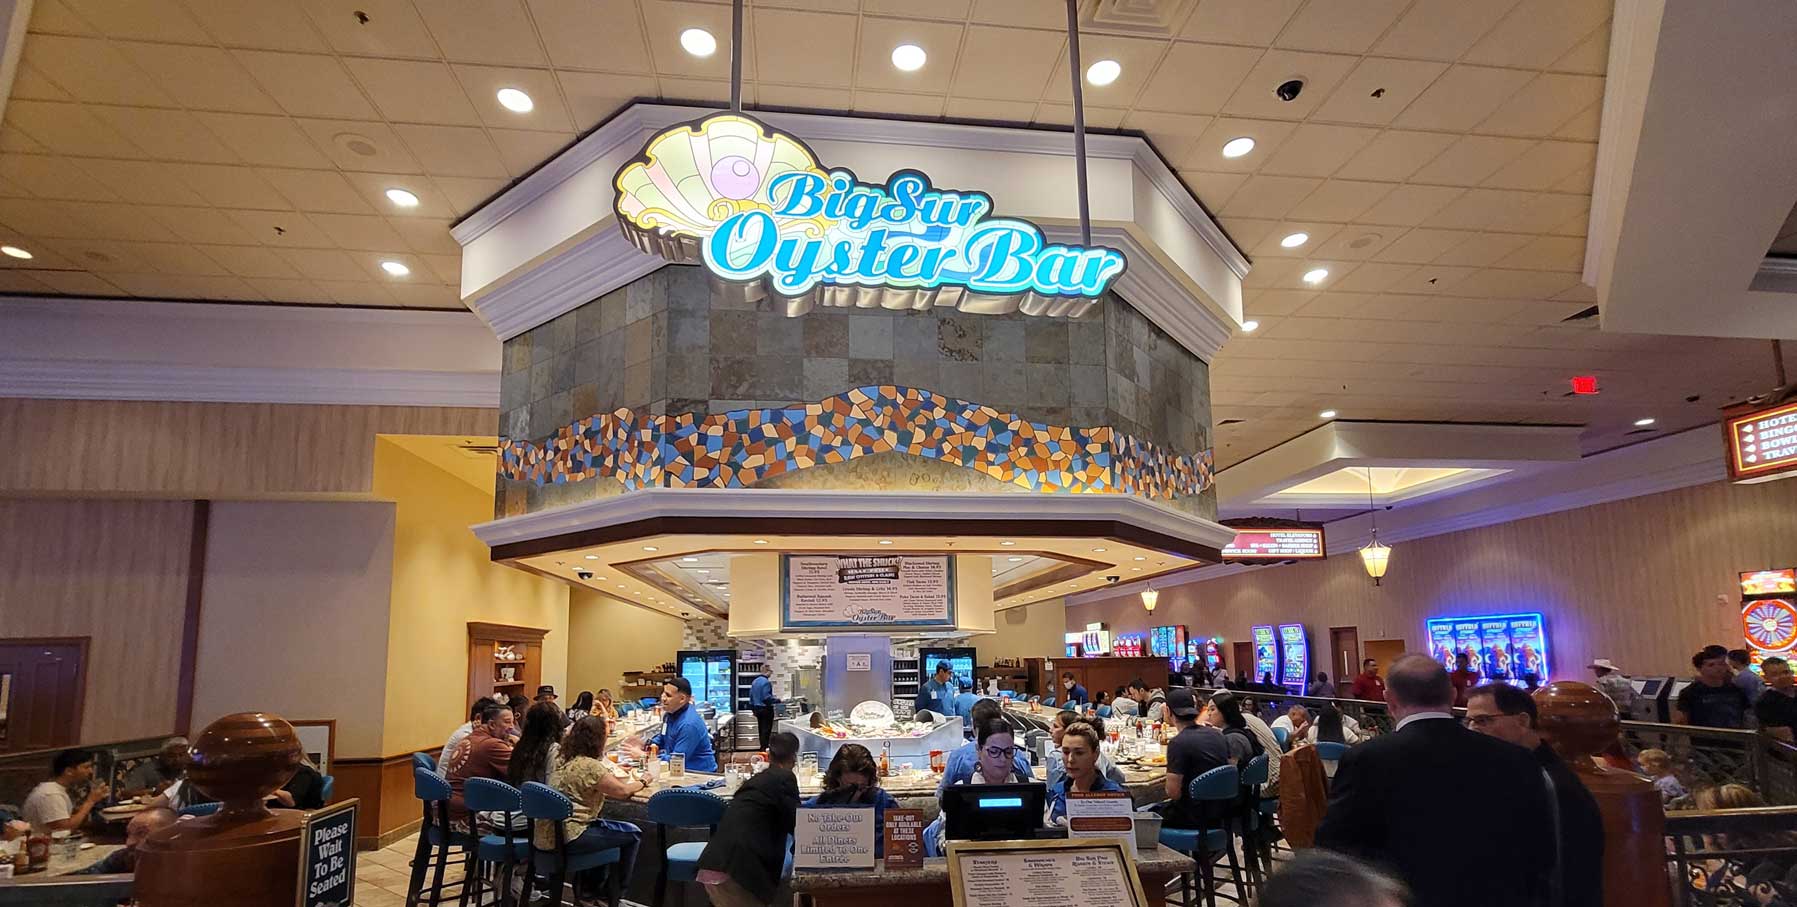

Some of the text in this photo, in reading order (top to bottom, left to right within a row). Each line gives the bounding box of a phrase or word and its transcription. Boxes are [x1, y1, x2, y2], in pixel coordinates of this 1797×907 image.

[767, 172, 983, 230] Big Sur
[711, 211, 1117, 288] Oyster Bar
[836, 557, 857, 569] WHAT
[858, 557, 872, 568] THE
[852, 613, 879, 622] Oyster
[807, 813, 863, 823] No Take-Out
[314, 822, 348, 846] Please
[819, 823, 851, 832] Orders
[812, 836, 857, 846] All Diners
[318, 839, 343, 860] Wait
[800, 845, 869, 855] Limited To One
[314, 856, 344, 879] To Be
[309, 867, 346, 898] Seated
